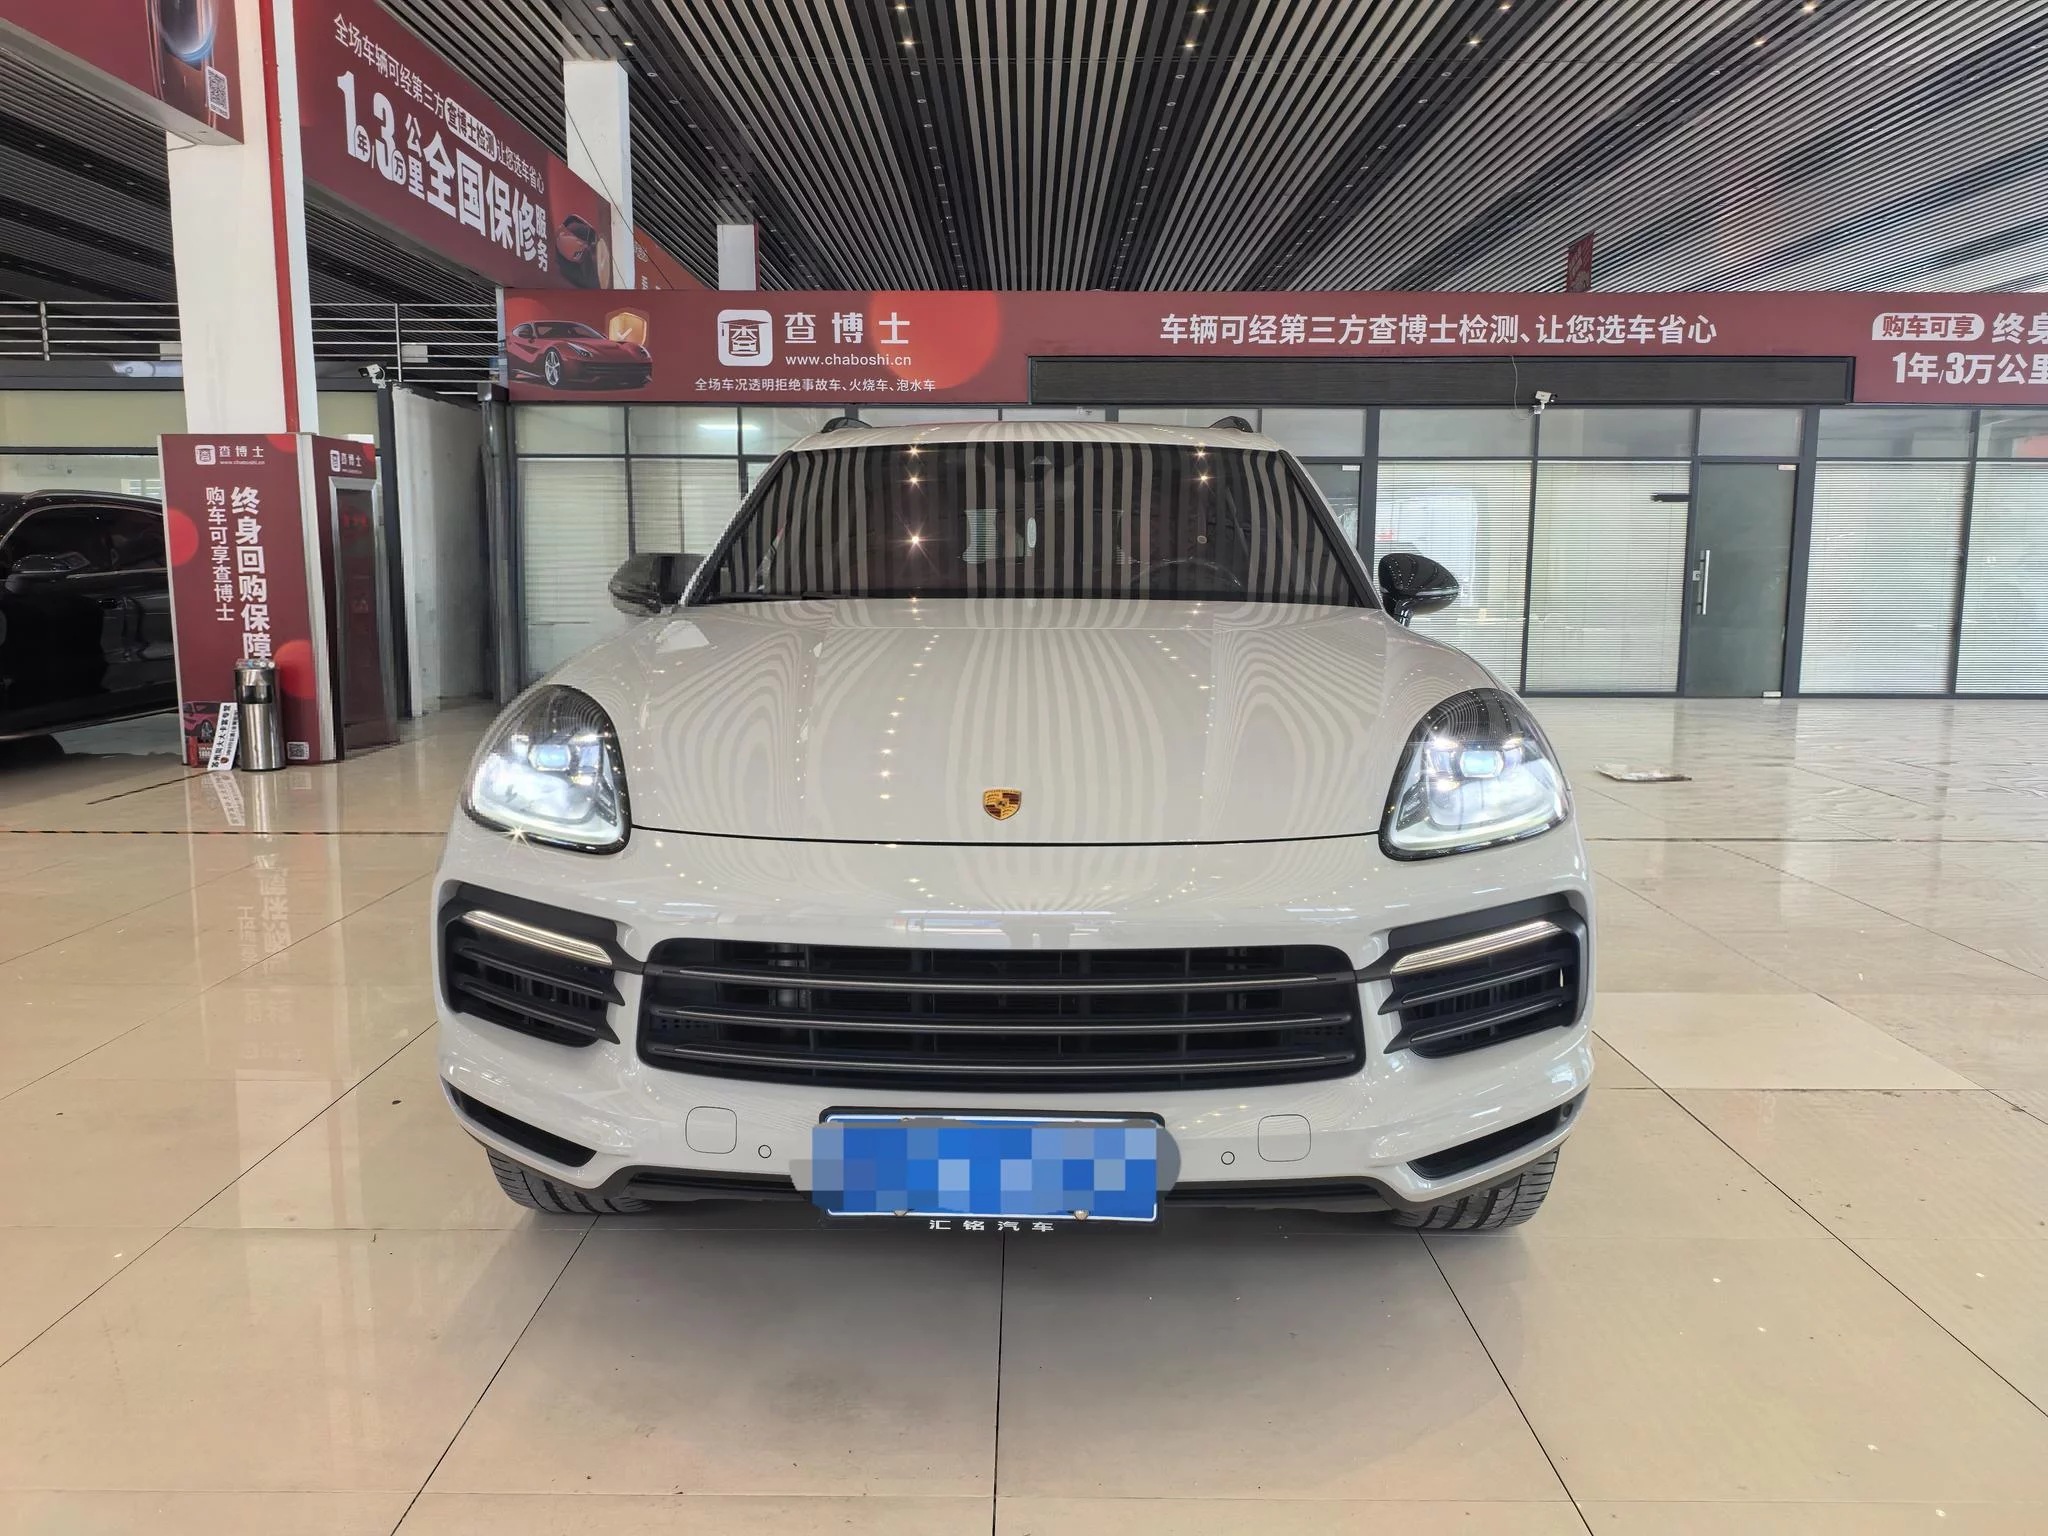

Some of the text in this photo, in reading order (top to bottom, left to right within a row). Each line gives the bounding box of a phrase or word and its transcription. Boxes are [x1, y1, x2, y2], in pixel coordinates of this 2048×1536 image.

[784, 312, 910, 345] 查博士
[1160, 314, 1717, 345] 车辆可经第三方查博士检测、让您选车省心
[1882, 315, 1976, 338] 购车可享
[785, 354, 912, 367] www.chaboshi.cn
[219, 445, 264, 458] 查博士
[206, 486, 235, 621] 购车可享查博士
[231, 486, 272, 660] 终身回购保障
[929, 1219, 1054, 1232] 汇铭汽车
